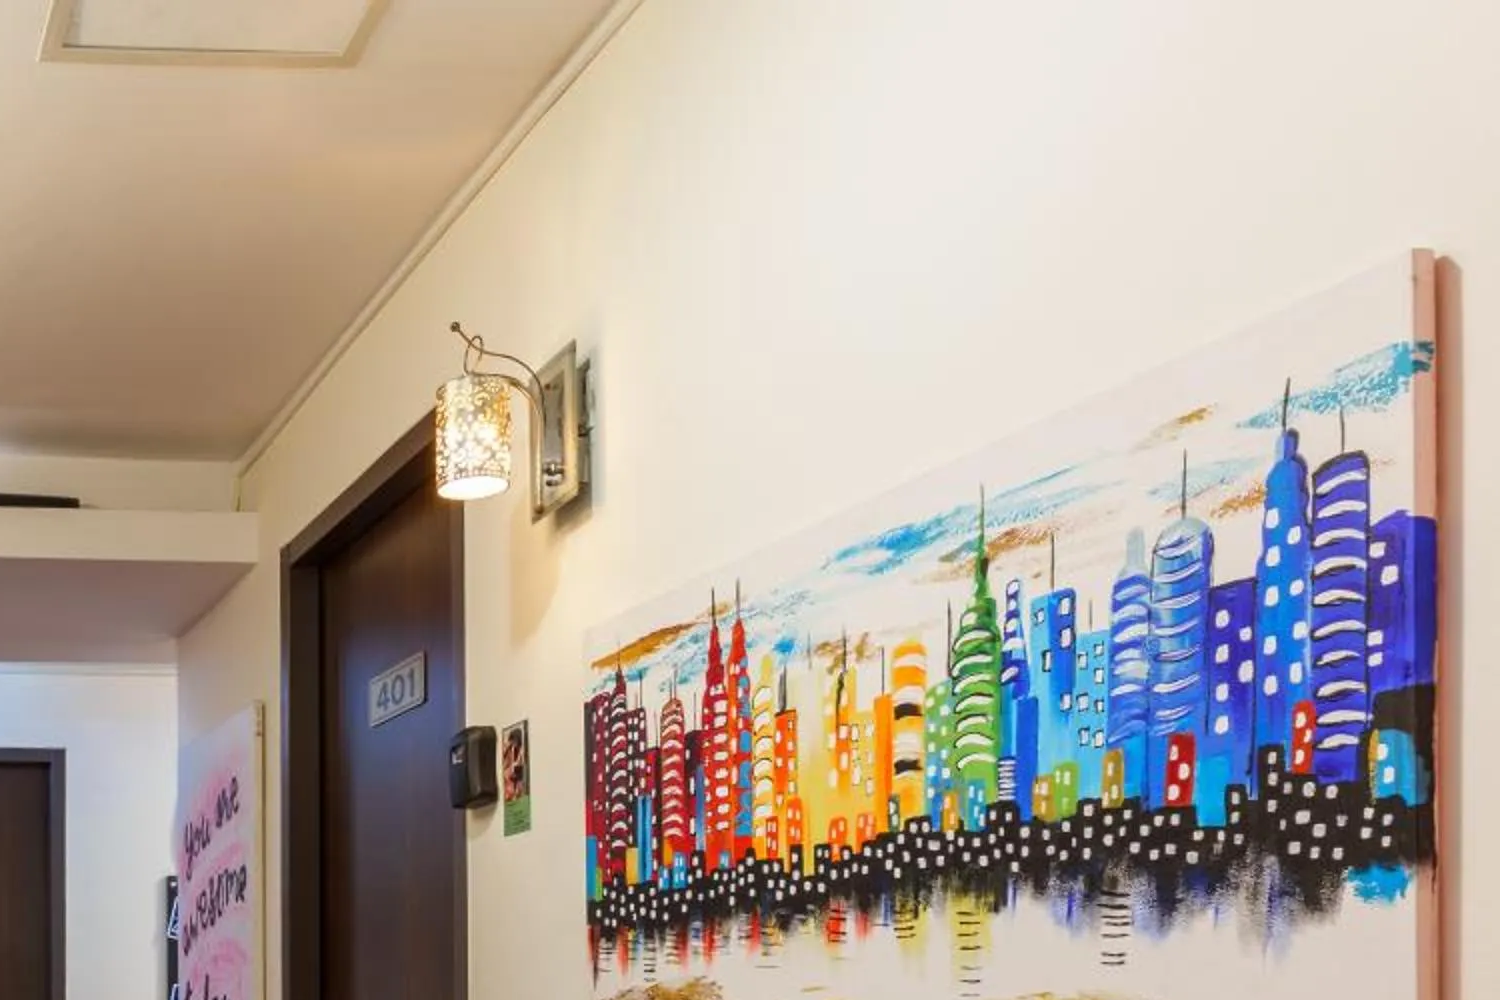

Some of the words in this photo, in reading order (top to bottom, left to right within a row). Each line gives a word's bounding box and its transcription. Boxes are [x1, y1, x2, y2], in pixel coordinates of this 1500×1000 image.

[376, 667, 415, 712] 401
[184, 815, 211, 881] you
[214, 776, 240, 829] are
